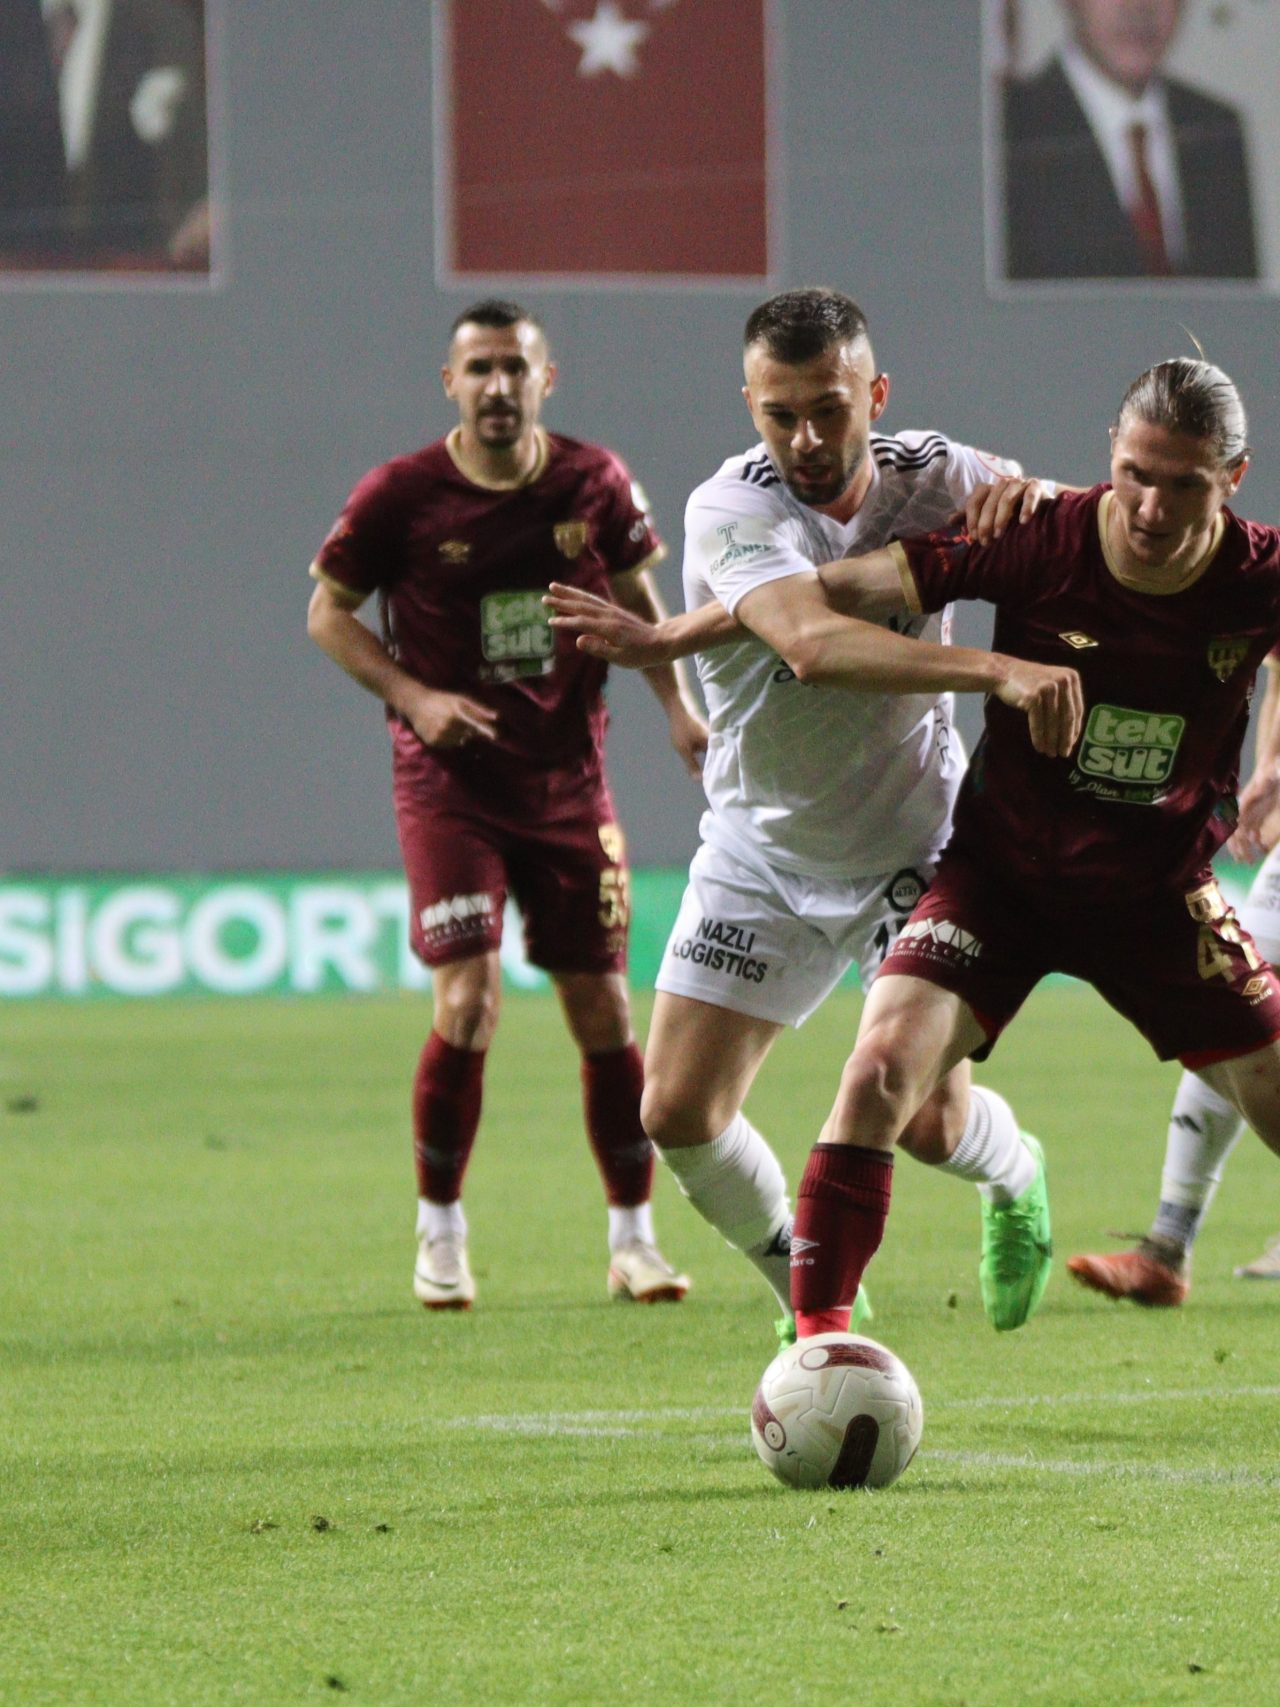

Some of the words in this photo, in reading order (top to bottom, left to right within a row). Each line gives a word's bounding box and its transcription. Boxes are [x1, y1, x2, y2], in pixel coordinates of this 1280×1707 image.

[1094, 709, 1178, 745] tek
[1085, 746, 1168, 780] süt
[696, 917, 756, 954] NAZLI
[673, 939, 768, 984] LOGISTICS
